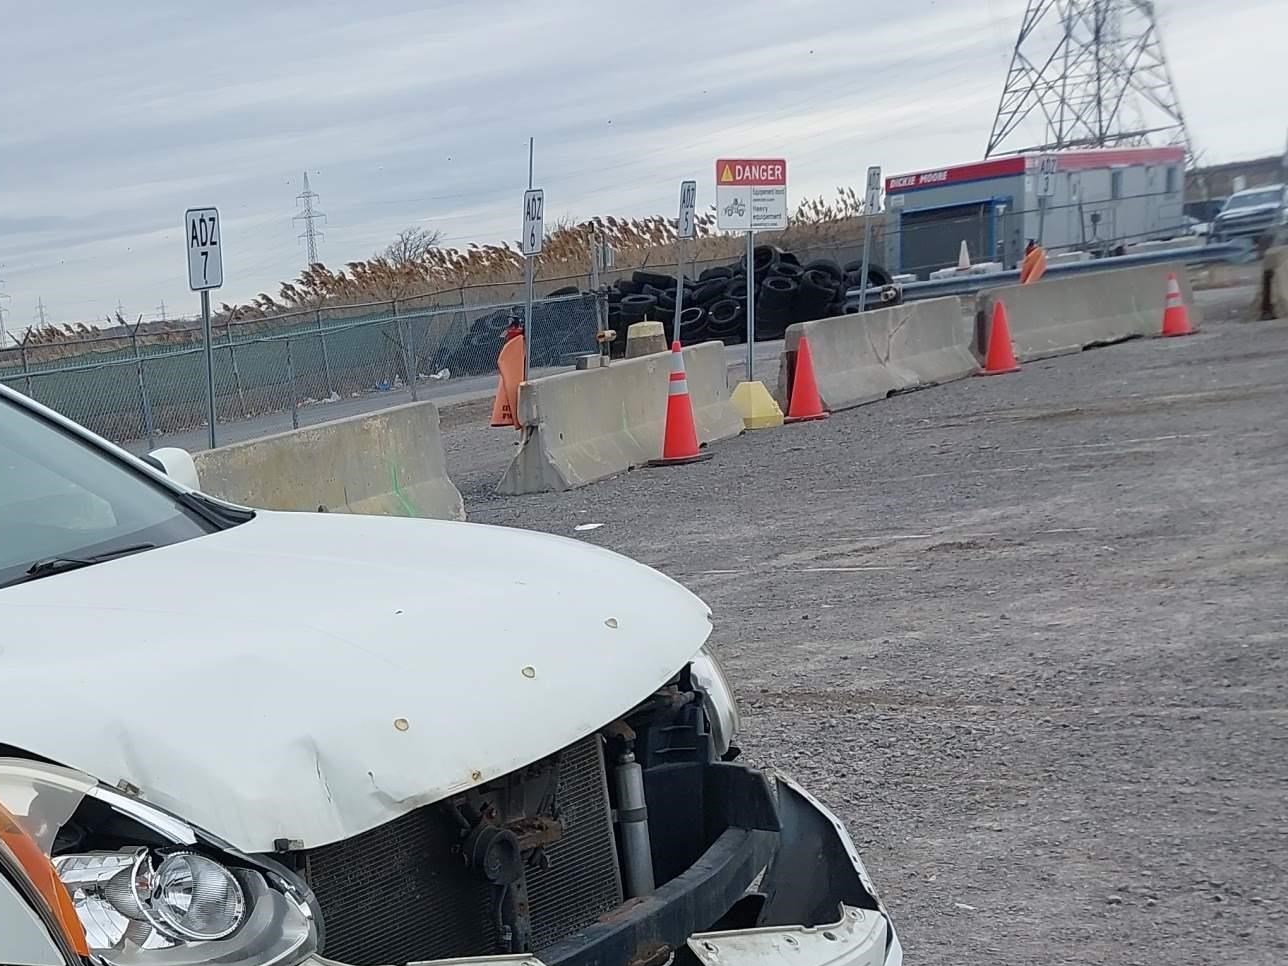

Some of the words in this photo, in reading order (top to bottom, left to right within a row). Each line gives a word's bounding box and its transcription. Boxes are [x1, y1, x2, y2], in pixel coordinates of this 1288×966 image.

[735, 165, 782, 180] DANGER
[525, 196, 542, 222] ADZ
[682, 187, 695, 209] ADZ
[190, 216, 218, 249] ADZ
[684, 211, 689, 232] 5
[529, 224, 536, 248] 6
[200, 251, 209, 280] 7
